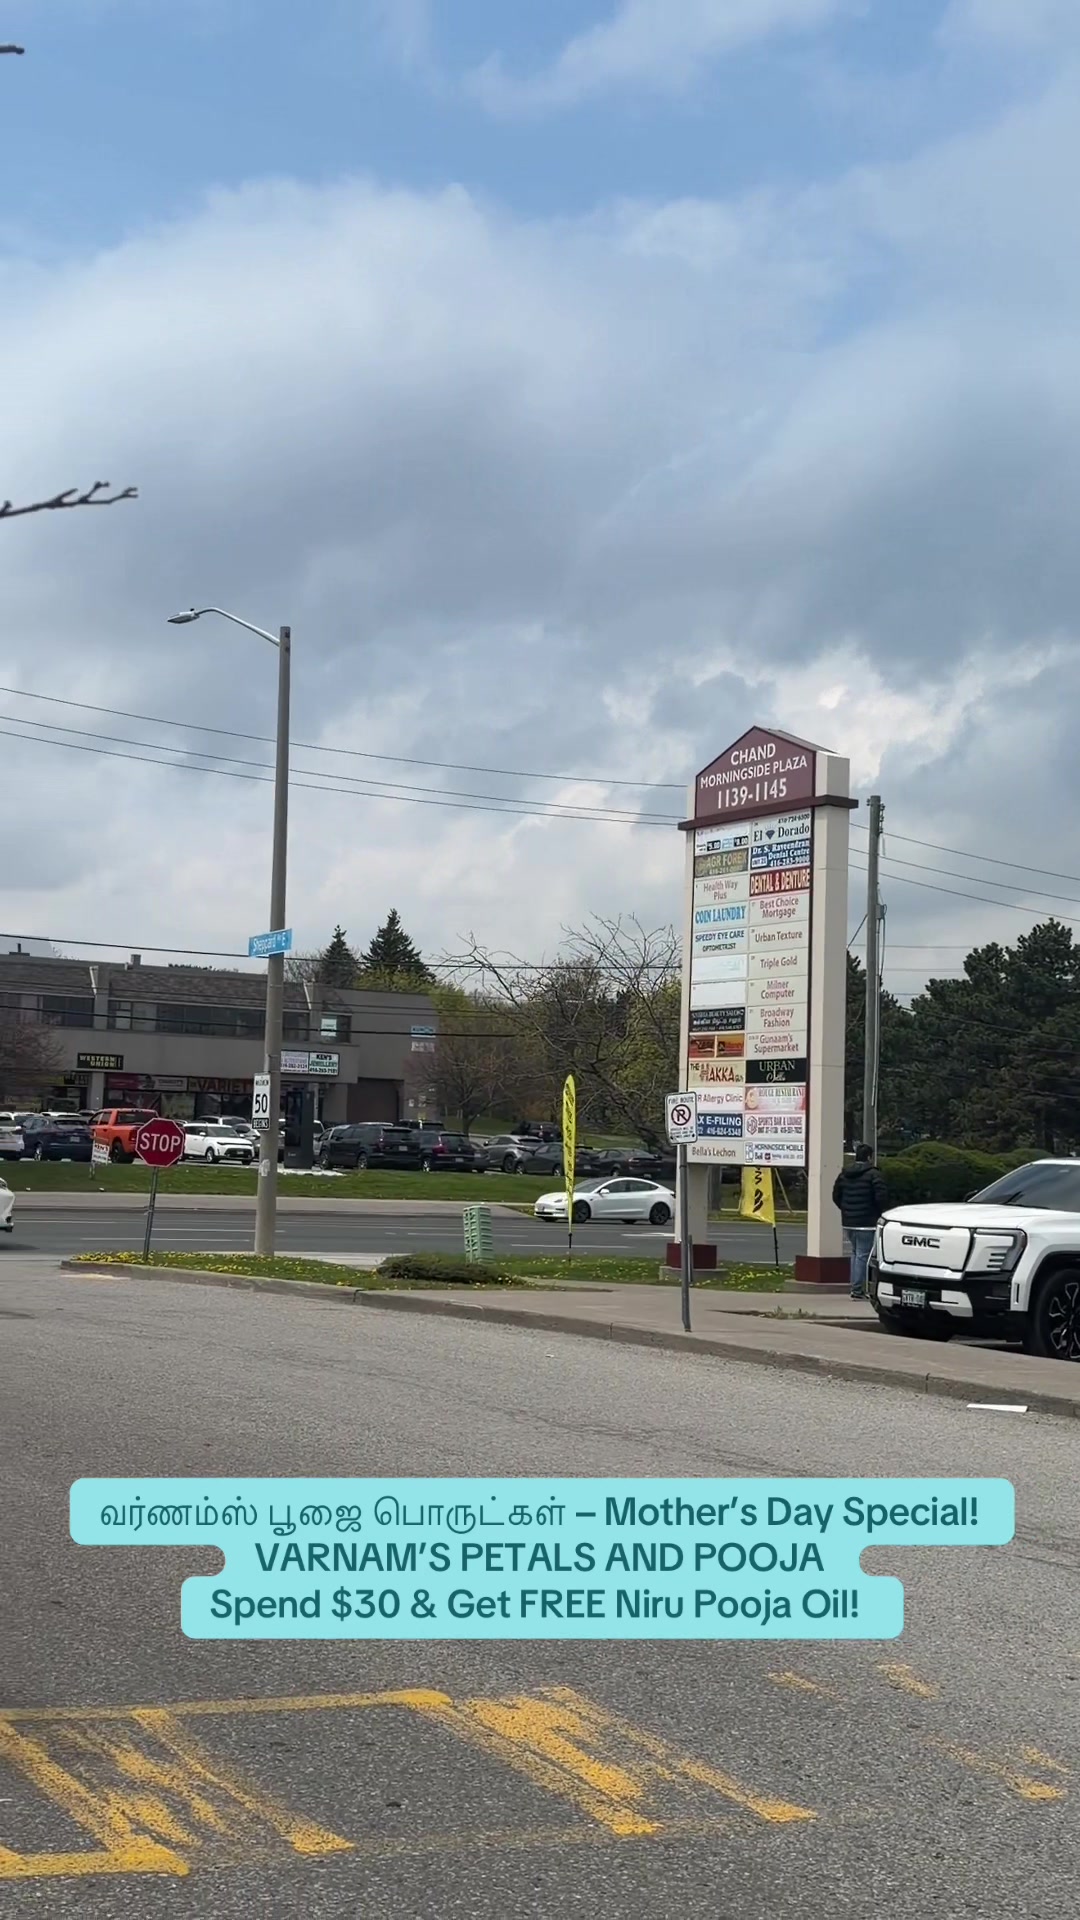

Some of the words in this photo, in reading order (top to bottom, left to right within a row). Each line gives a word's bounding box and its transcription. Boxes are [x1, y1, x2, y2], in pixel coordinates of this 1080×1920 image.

[730, 743, 776, 766] CHAND
[700, 763, 770, 789] MORNINGSIDE
[773, 755, 808, 774] PLAZA
[718, 778, 787, 808] 1139-1145
[754, 830, 762, 842] El
[778, 822, 810, 838] Dorado
[722, 852, 747, 864] FOREX
[768, 850, 788, 860] Dental
[790, 848, 810, 856] Centre
[704, 881, 724, 891] Health
[725, 880, 738, 890] Way
[751, 873, 774, 894] DENTAL
[781, 868, 810, 890] DENTURE
[714, 892, 727, 900] Plus
[760, 900, 774, 909] Best
[776, 897, 799, 907] Choice
[695, 910, 711, 924] COIN
[713, 906, 746, 922] LAUNDRY
[762, 907, 796, 919] Mortgage
[695, 933, 716, 942] SPEEDY
[717, 932, 728, 940] EYE
[729, 930, 744, 938] CARE
[755, 932, 776, 942] Urban
[776, 930, 802, 940] Texture
[253, 936, 276, 953] Sheppard
[282, 932, 286, 946] E
[702, 942, 736, 952] OPTOMETRIST
[760, 958, 779, 969] Triple
[780, 956, 797, 966] Gold
[767, 980, 789, 989] Milner
[760, 989, 794, 1000] Computer
[760, 1008, 794, 1018] Broadway
[764, 1019, 790, 1028] Fashion
[754, 1043, 798, 1055] Supermarket
[760, 1060, 795, 1071] URBAN
[700, 1063, 734, 1082] HAKKA
[197, 1078, 254, 1094] VARIET
[255, 1094, 268, 1113] 50
[704, 1094, 724, 1104] Allergy
[726, 1094, 743, 1102] Clinic
[254, 1120, 268, 1128] BEGINS
[706, 1116, 741, 1126] E-FILING
[758, 1117, 772, 1126] SPORTS
[774, 1117, 782, 1126] BAR
[787, 1117, 802, 1126] LOUNGE
[140, 1133, 180, 1152] STOP
[692, 1147, 712, 1156] Bella's
[713, 1147, 736, 1157] Lechon
[902, 1235, 940, 1249] GMC
